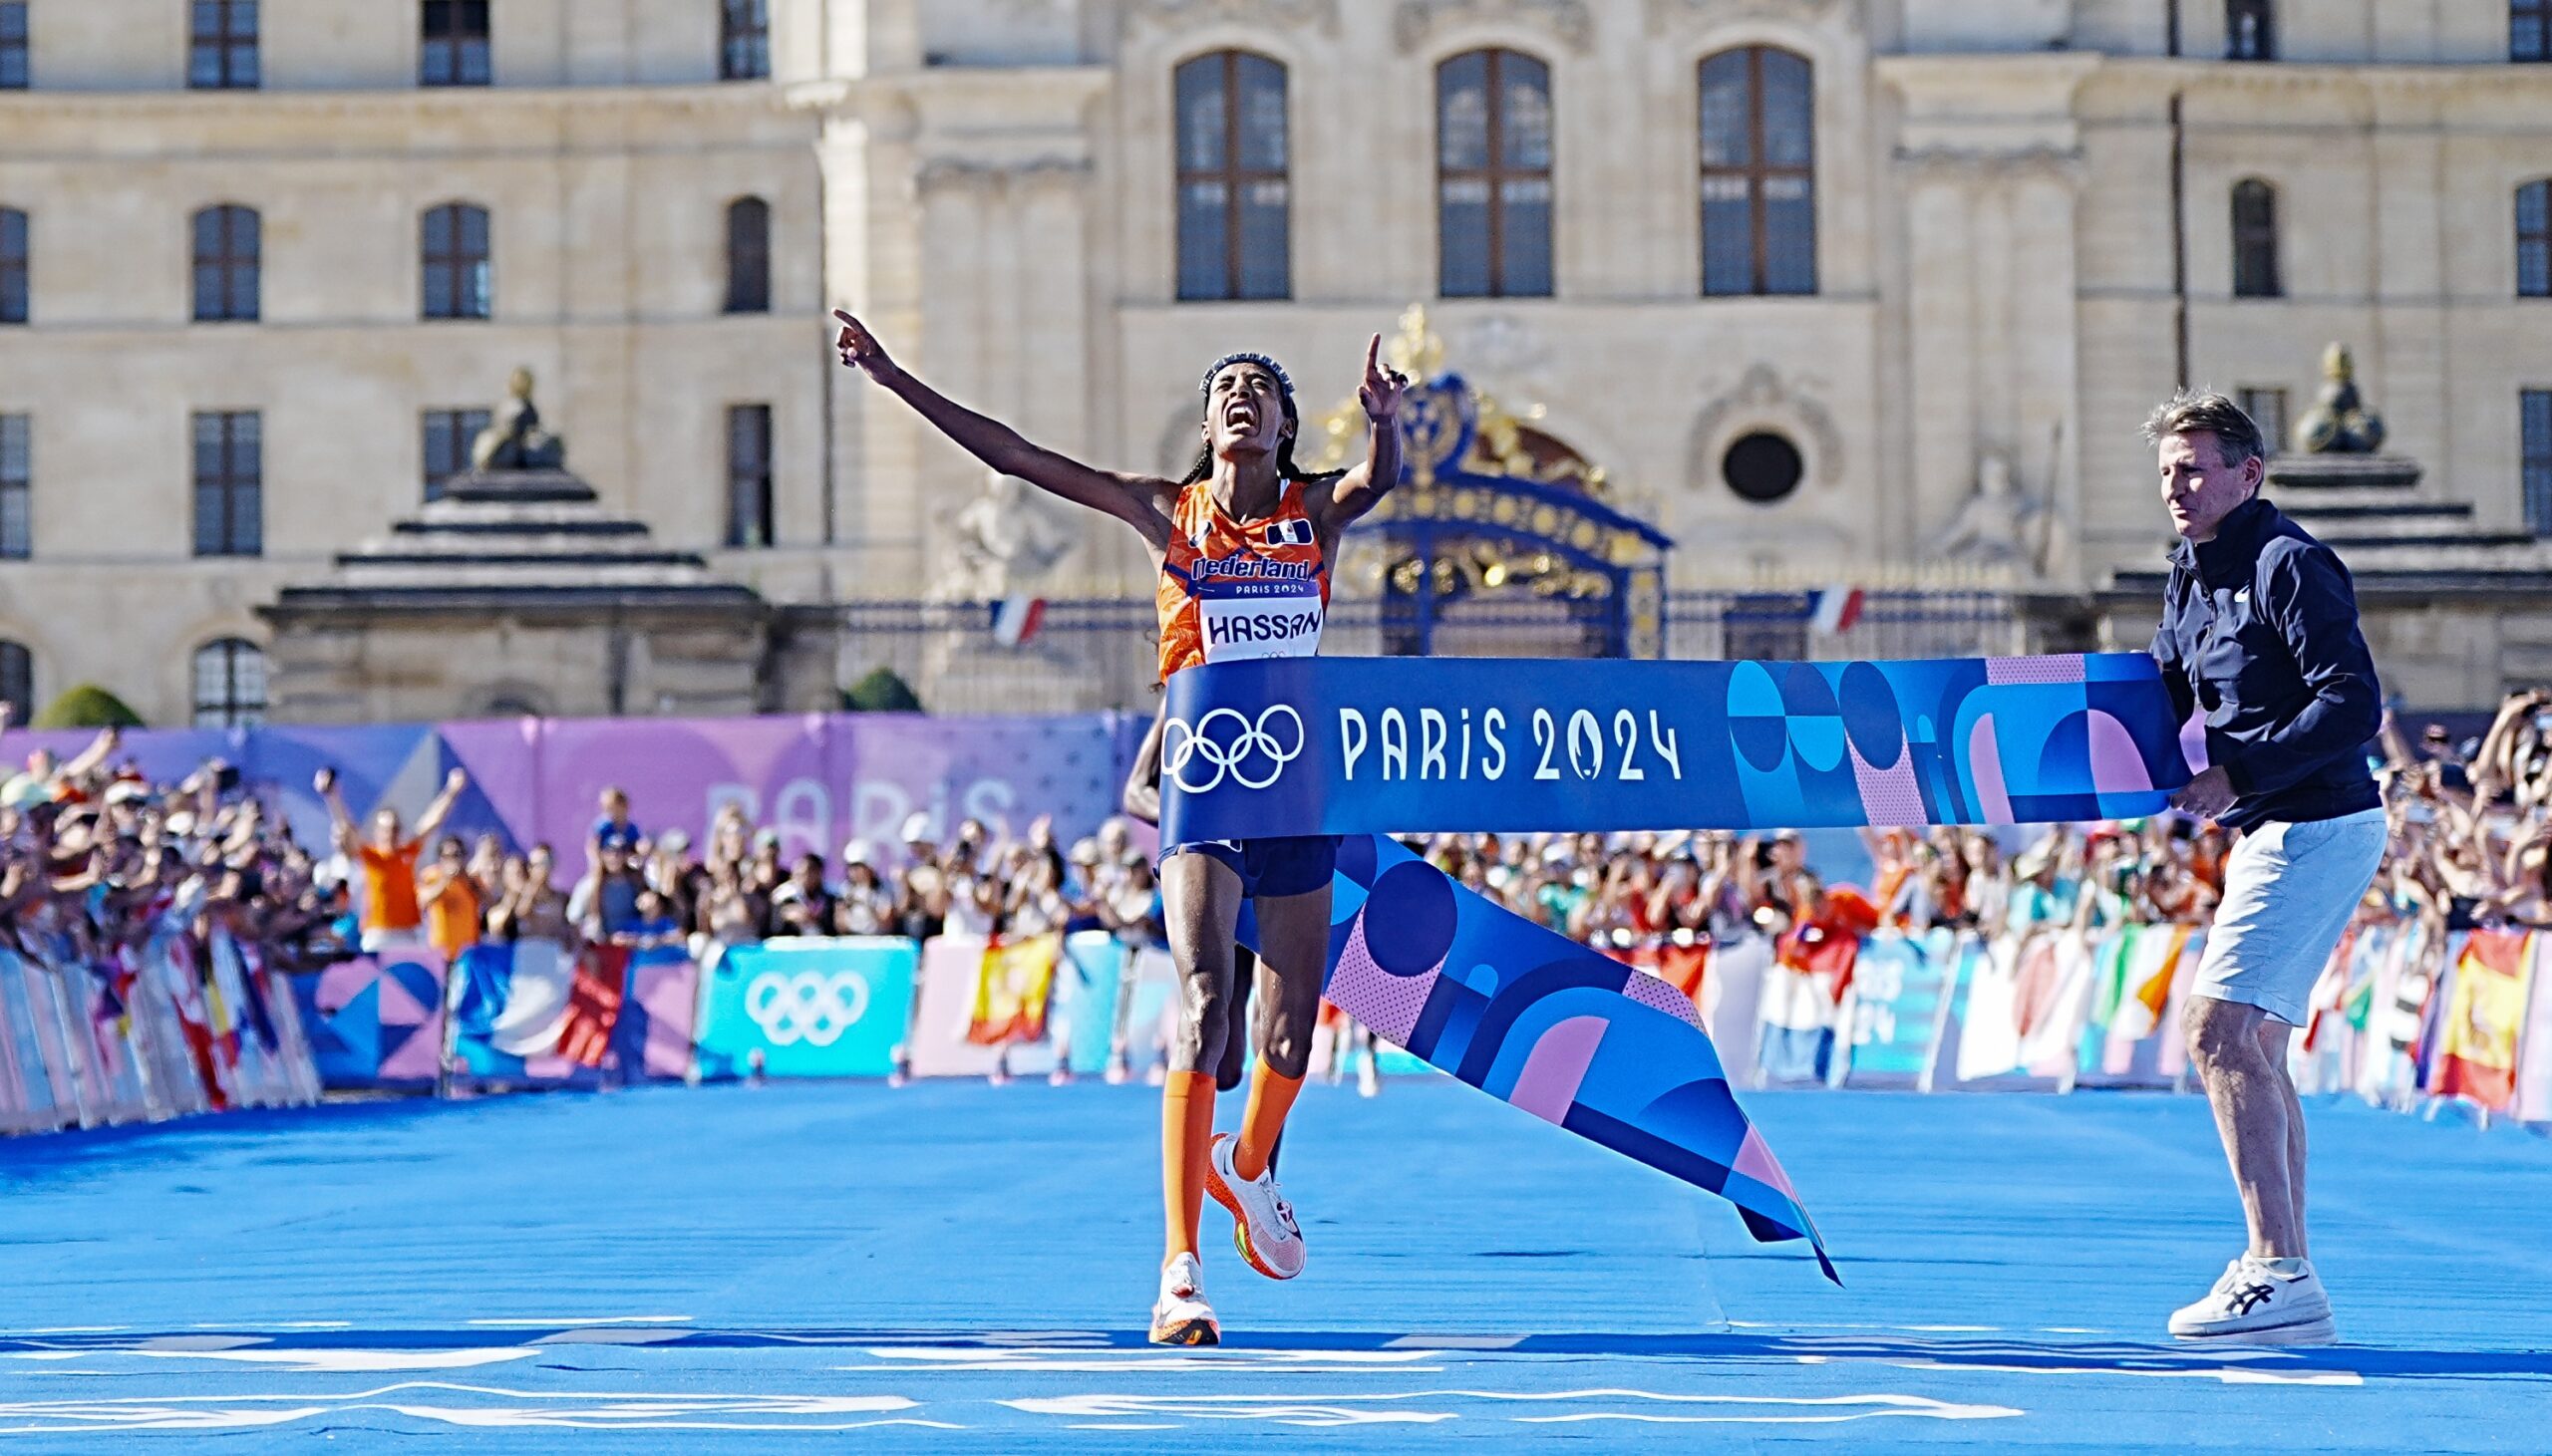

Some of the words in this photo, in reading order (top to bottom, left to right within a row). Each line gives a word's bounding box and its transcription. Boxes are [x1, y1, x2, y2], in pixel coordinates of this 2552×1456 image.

[1274, 584, 1304, 593] 2024
[1208, 608, 1322, 645] HASSAN
[1532, 708, 1682, 780] 2024
